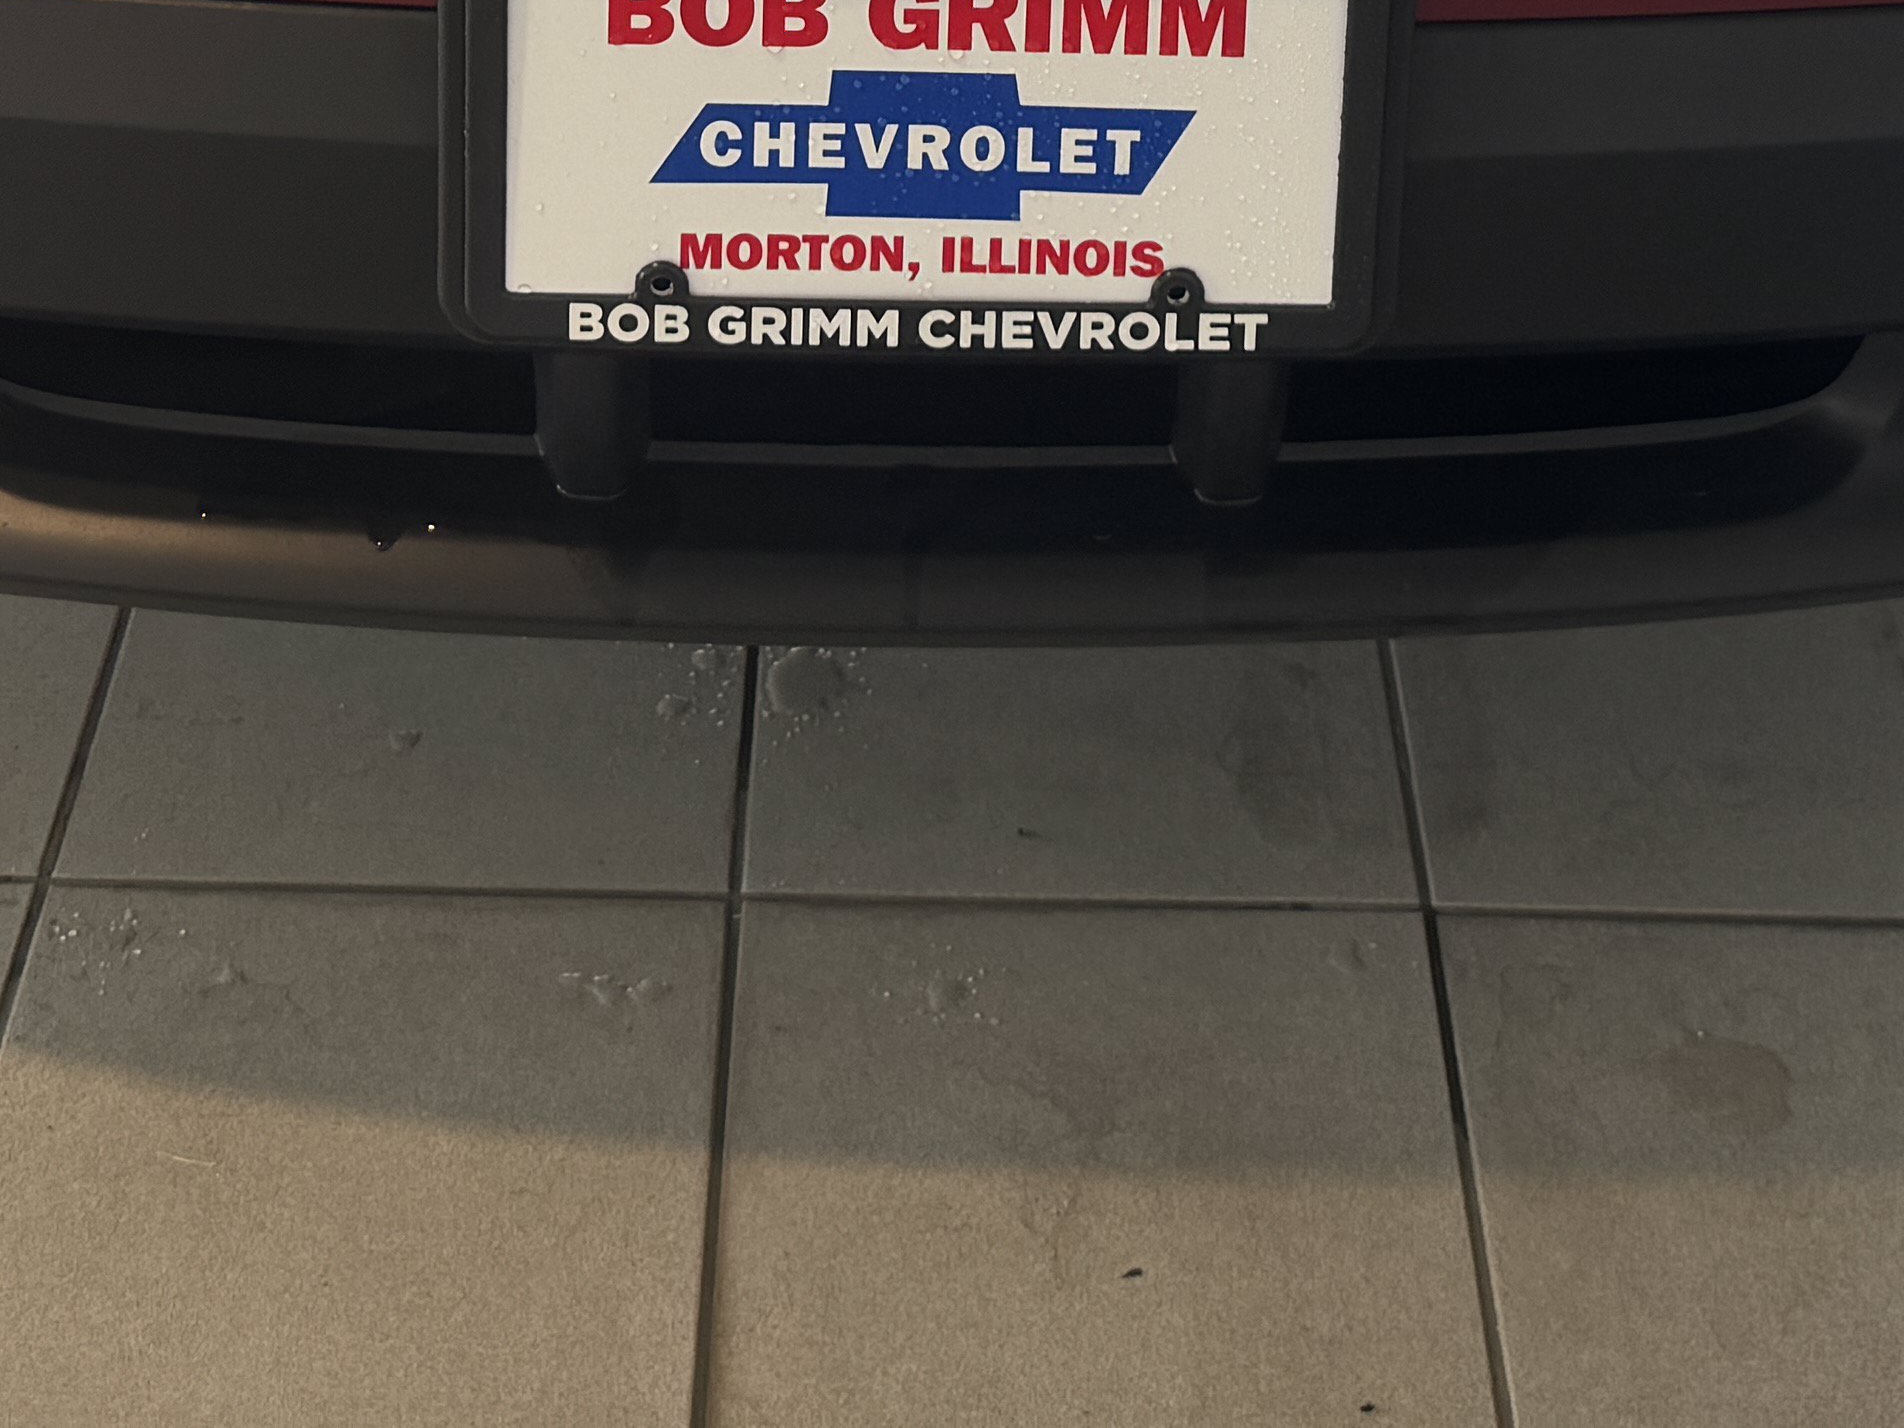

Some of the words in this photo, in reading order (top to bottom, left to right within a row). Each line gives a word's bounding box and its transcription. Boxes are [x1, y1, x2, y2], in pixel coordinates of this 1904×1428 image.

[699, 120, 1141, 176] CHEVROLET
[679, 233, 921, 281] MORTON,
[941, 236, 1165, 279] ILLINOIS
[568, 302, 691, 343] BOB
[707, 305, 900, 347] GRIMM
[918, 309, 1269, 352] CHEVROLET
